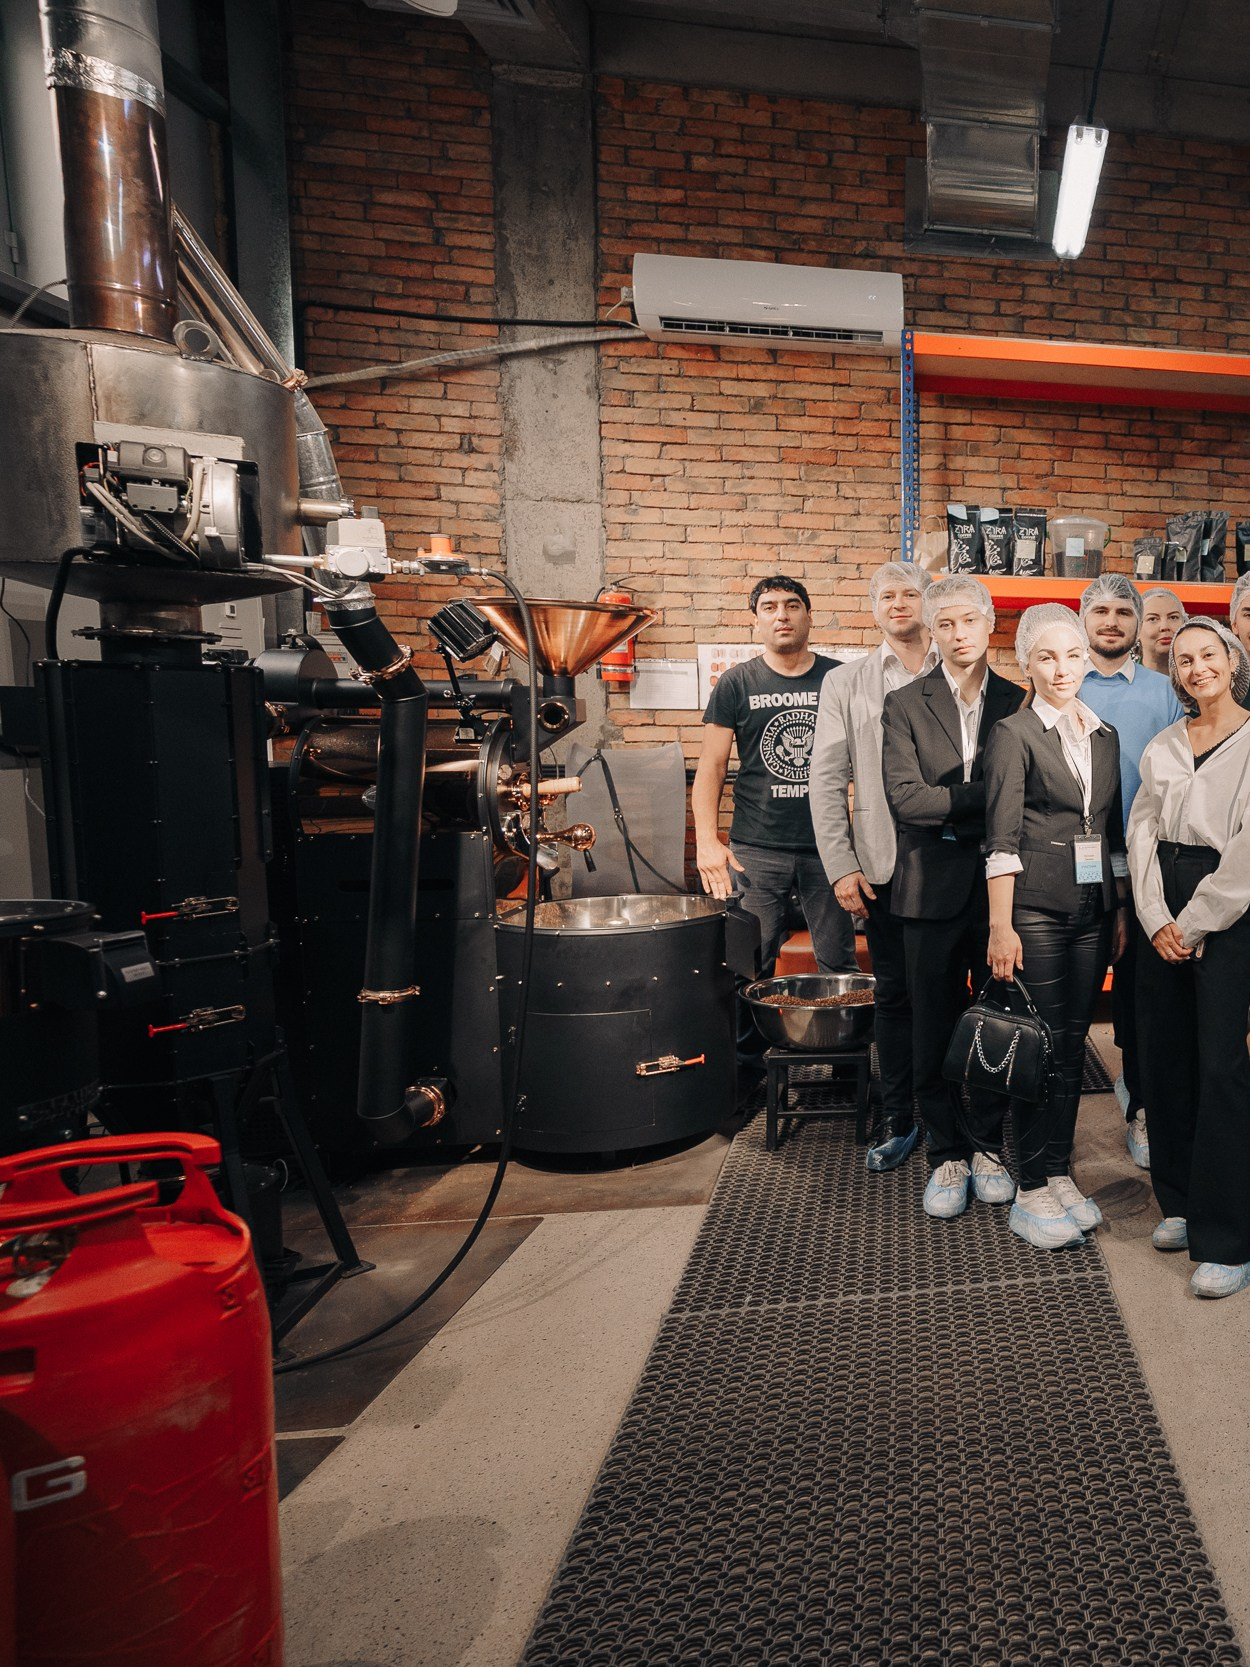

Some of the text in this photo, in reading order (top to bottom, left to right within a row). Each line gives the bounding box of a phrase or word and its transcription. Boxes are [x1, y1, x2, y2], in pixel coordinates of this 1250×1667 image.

[749, 692, 818, 710] BROOME
[778, 712, 815, 724] RADHA
[763, 726, 780, 771] GANESHA
[770, 785, 809, 798] TEMP
